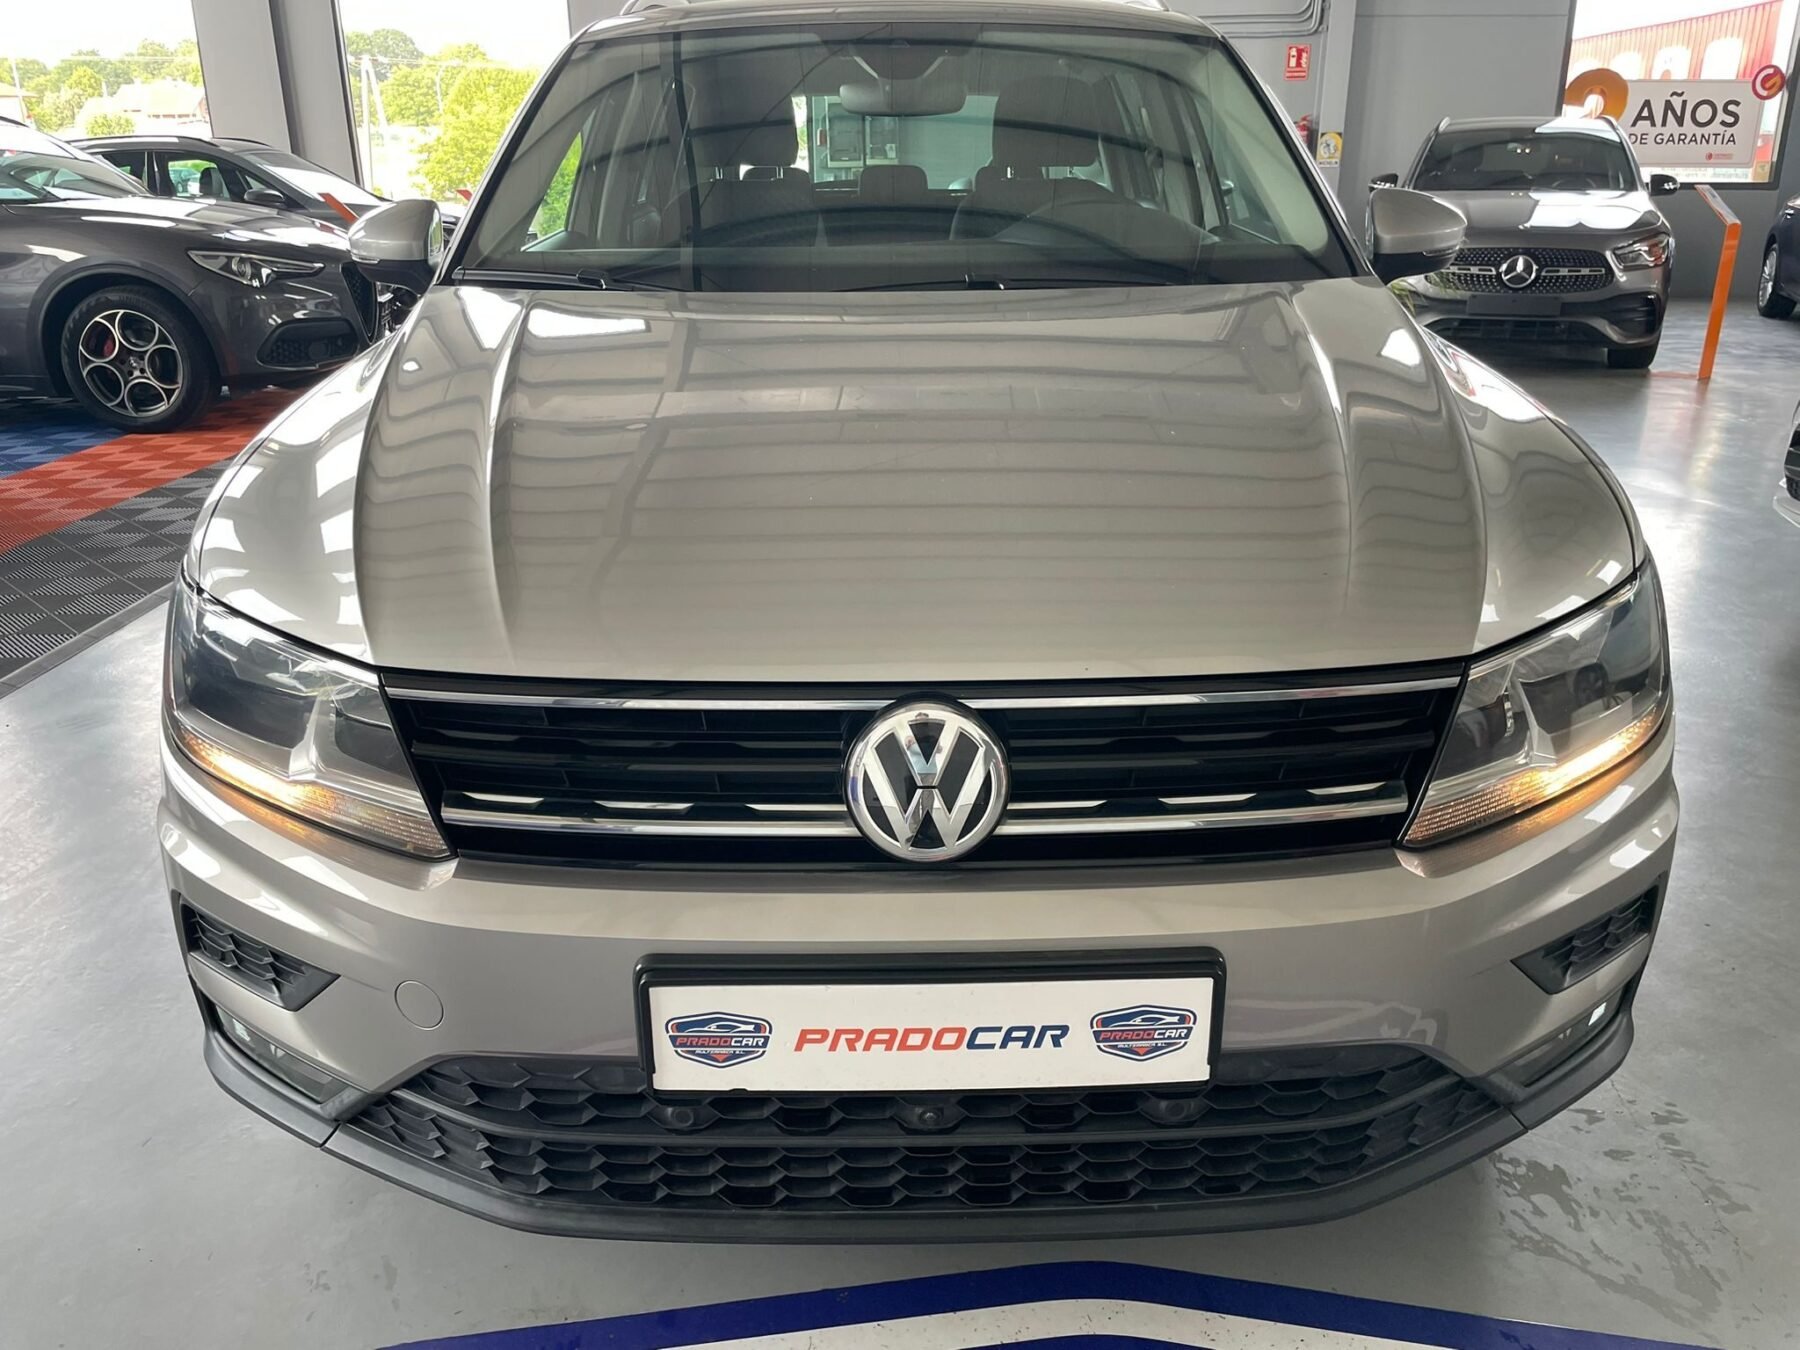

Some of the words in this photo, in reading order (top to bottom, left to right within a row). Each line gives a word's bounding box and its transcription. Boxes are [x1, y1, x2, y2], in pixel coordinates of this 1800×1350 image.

[1630, 91, 1742, 128] AÑOS
[1628, 133, 1649, 145] DE
[1654, 130, 1736, 145] GARANTÍA
[793, 1024, 1070, 1052] PRADOCAR
[1099, 1028, 1188, 1040] PRADOCAR
[675, 1037, 765, 1047] PRADOCAR
